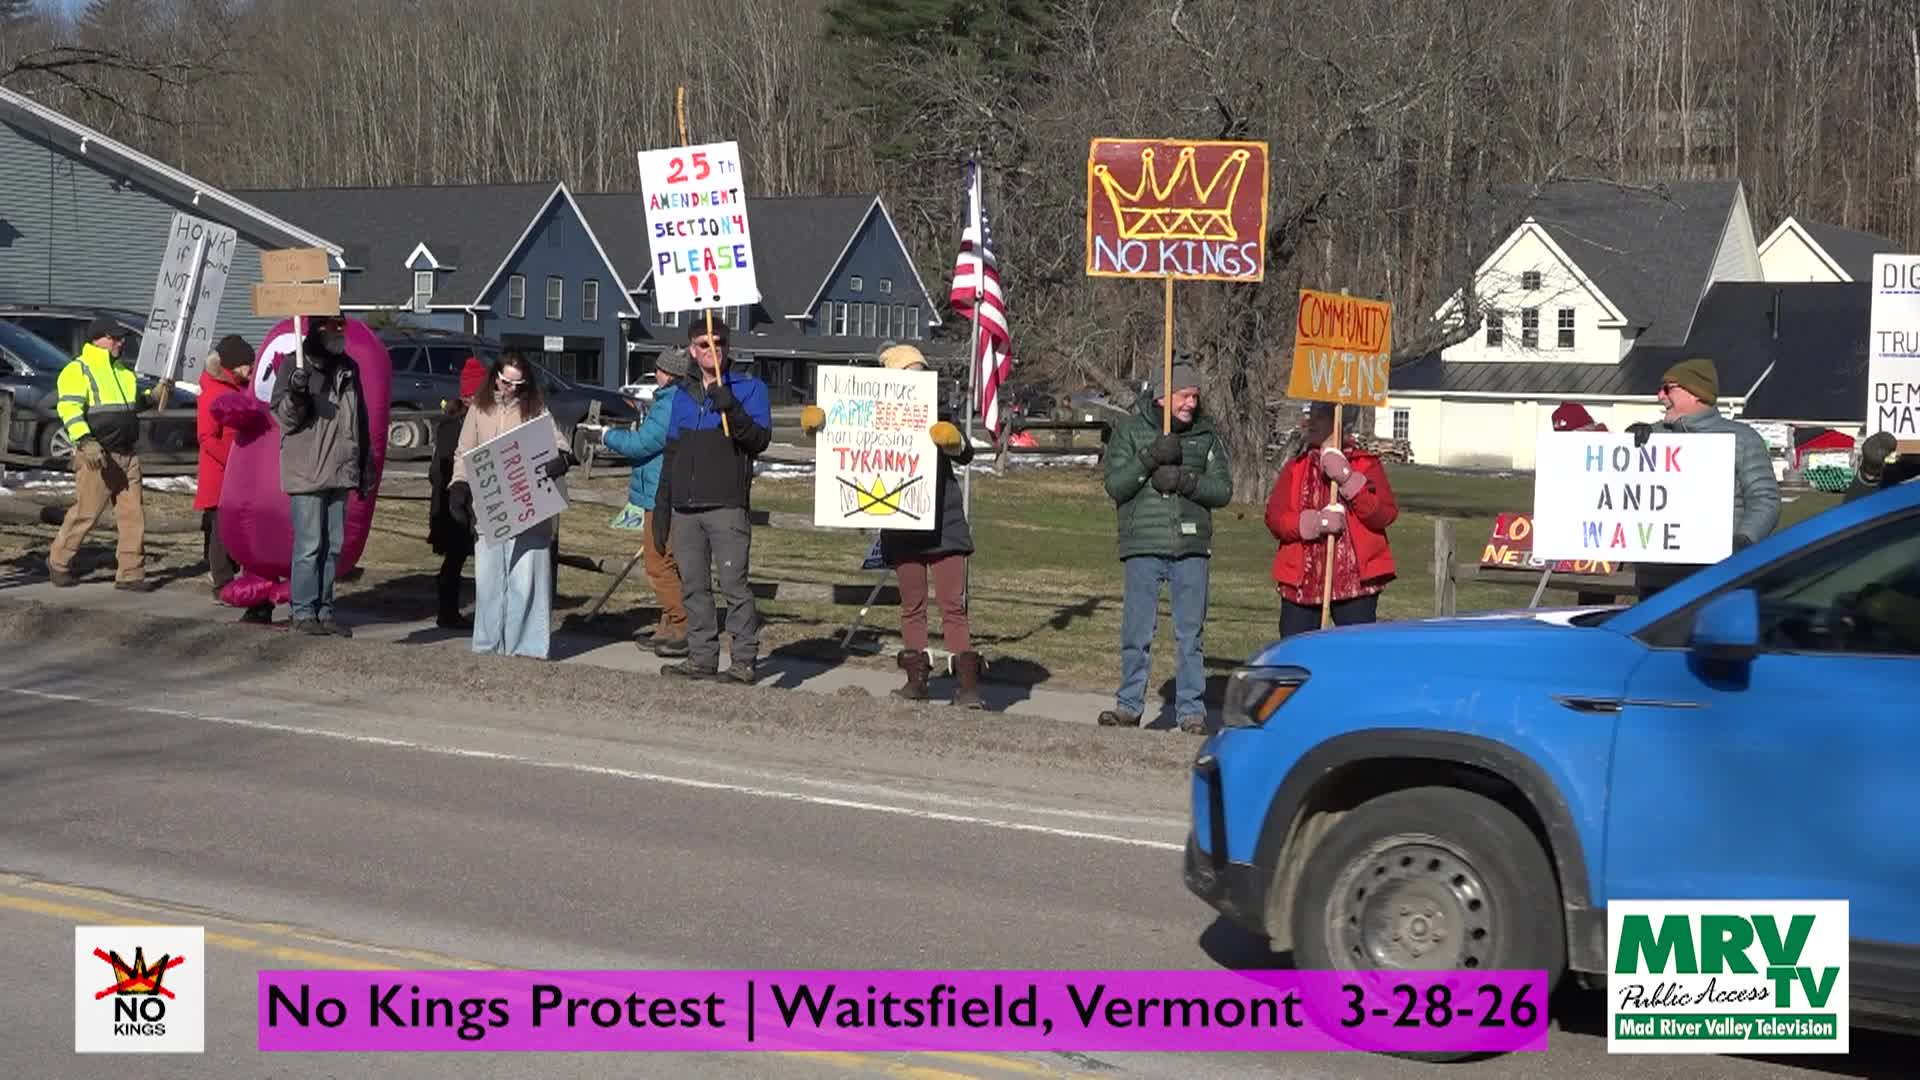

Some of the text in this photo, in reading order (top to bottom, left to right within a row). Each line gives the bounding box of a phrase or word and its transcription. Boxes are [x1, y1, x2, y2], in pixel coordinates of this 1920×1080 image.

[666, 152, 711, 184] 25
[650, 188, 738, 210] AMENDMENT
[177, 215, 235, 257] HONK
[657, 244, 748, 276] PLEASE
[1095, 235, 1258, 276] NO KINGS
[163, 269, 191, 293] NOT
[1298, 293, 1390, 348] COMMUNITY
[824, 373, 881, 400] Nothing
[1309, 349, 1391, 401] WINS
[856, 431, 914, 455] opposing
[1586, 445, 1682, 472] HONK
[832, 447, 920, 478] TYRANNY
[471, 448, 512, 539] GESTAPO
[500, 441, 536, 522] TRUMP'S
[1597, 483, 1668, 511] AND
[1582, 521, 1681, 550] WAVE
